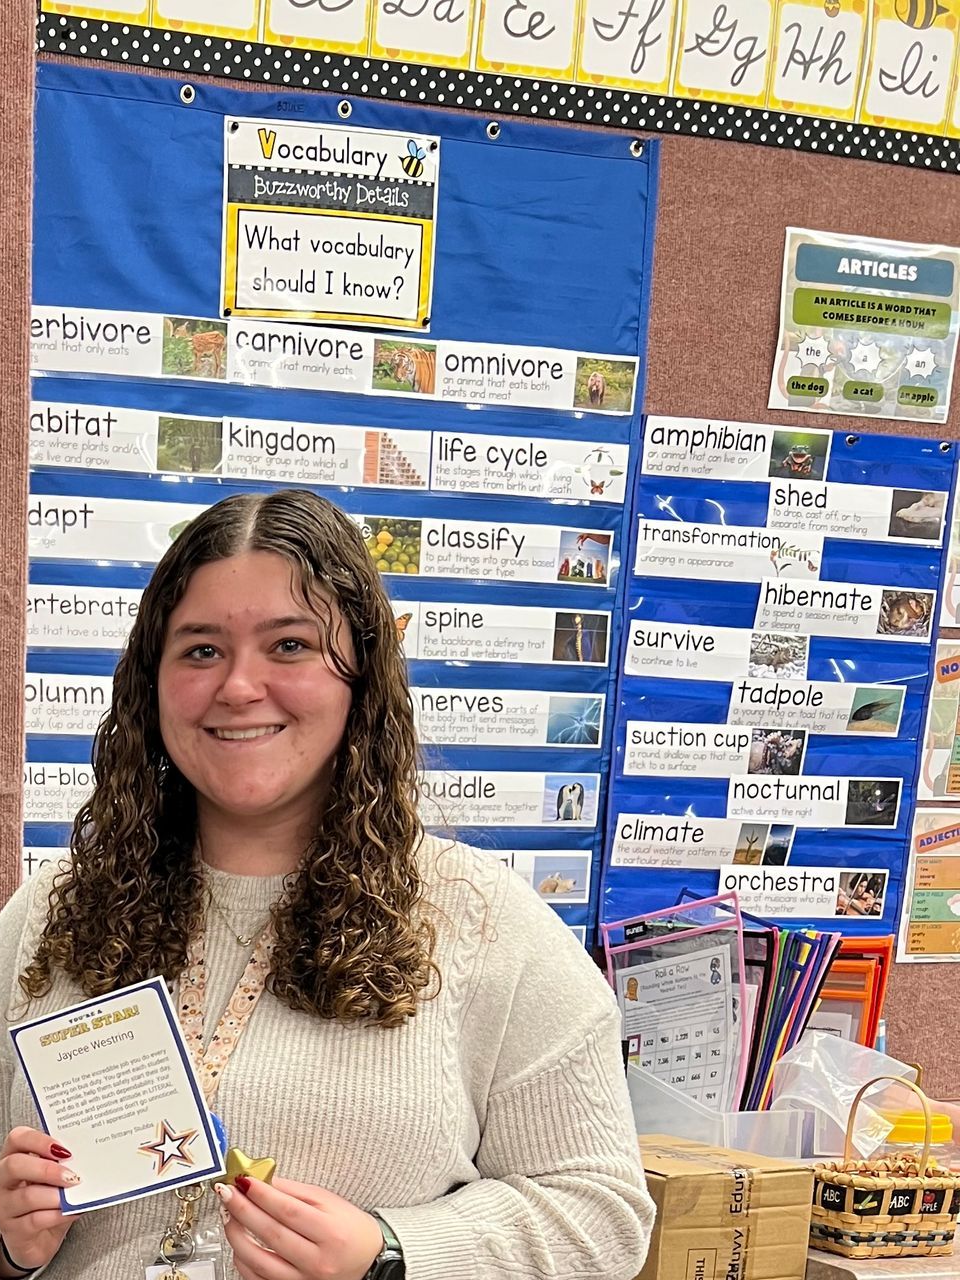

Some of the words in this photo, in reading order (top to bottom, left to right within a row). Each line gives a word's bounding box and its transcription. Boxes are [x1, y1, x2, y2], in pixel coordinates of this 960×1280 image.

[684, 3, 767, 87] Gg
[782, 22, 852, 85] Hh
[257, 128, 388, 177] Vocabulary
[253, 175, 353, 204] Buzzworthy
[356, 183, 410, 208] Details
[244, 224, 300, 252] What
[310, 232, 415, 269] vocabulary
[837, 257, 918, 282] ARTICLES
[252, 266, 316, 294] should
[324, 270, 334, 295] I
[342, 271, 405, 300] know?
[814, 296, 829, 305] AN
[829, 298, 866, 309] ARTICLE
[867, 301, 876, 310] IS
[877, 302, 884, 311] A
[885, 303, 912, 315] WORD
[914, 306, 937, 317] THAT
[822, 311, 855, 323] COMES
[855, 314, 890, 326] BEFORE
[30, 313, 152, 345] erbivore
[235, 331, 364, 361] carnivore
[805, 346, 821, 358] the
[862, 354, 868, 363] a
[444, 353, 564, 380] omnivore
[915, 359, 926, 369] an
[469, 388, 485, 399] and
[487, 377, 506, 388] that
[530, 381, 550, 391] both
[791, 381, 807, 391] the
[807, 383, 825, 395] dog
[859, 387, 873, 396] cat
[911, 392, 935, 403] apple
[29, 407, 118, 438] abitat
[229, 422, 335, 456] kingdom
[650, 423, 767, 454] amphibian
[438, 436, 478, 463] life
[486, 442, 548, 471] cycle
[774, 483, 828, 510] shed
[28, 501, 95, 534] dapt
[807, 520, 829, 531] from
[426, 523, 526, 558] classify
[642, 523, 782, 550] transformation
[26, 593, 139, 617] ertebrate
[764, 581, 873, 611] hibernate
[424, 607, 484, 633] spine
[633, 629, 716, 653] survive
[940, 662, 960, 676] NO
[24, 678, 105, 705] olumn
[421, 693, 504, 713] nerves
[738, 680, 824, 711] tadpole
[631, 726, 707, 748] suction
[713, 731, 750, 753] cup
[23, 766, 98, 787] ld-blo
[417, 775, 497, 799] huddle
[733, 778, 841, 802] nocturnal
[781, 806, 794, 817] the
[620, 818, 705, 844] climate
[919, 828, 960, 848] ADJECTI
[724, 870, 835, 893] orchestra
[40, 1023, 90, 1048] SUPER
[91, 1004, 140, 1030] STAR!
[55, 1043, 90, 1063] Jaycee
[90, 1029, 134, 1051] Westring
[43, 1082, 60, 1092] Thank
[129, 1057, 141, 1065] you
[729, 1172, 745, 1214] Edu
[823, 1188, 841, 1203] ABC
[889, 1195, 910, 1209] ABC
[920, 1202, 938, 1212] PPLE
